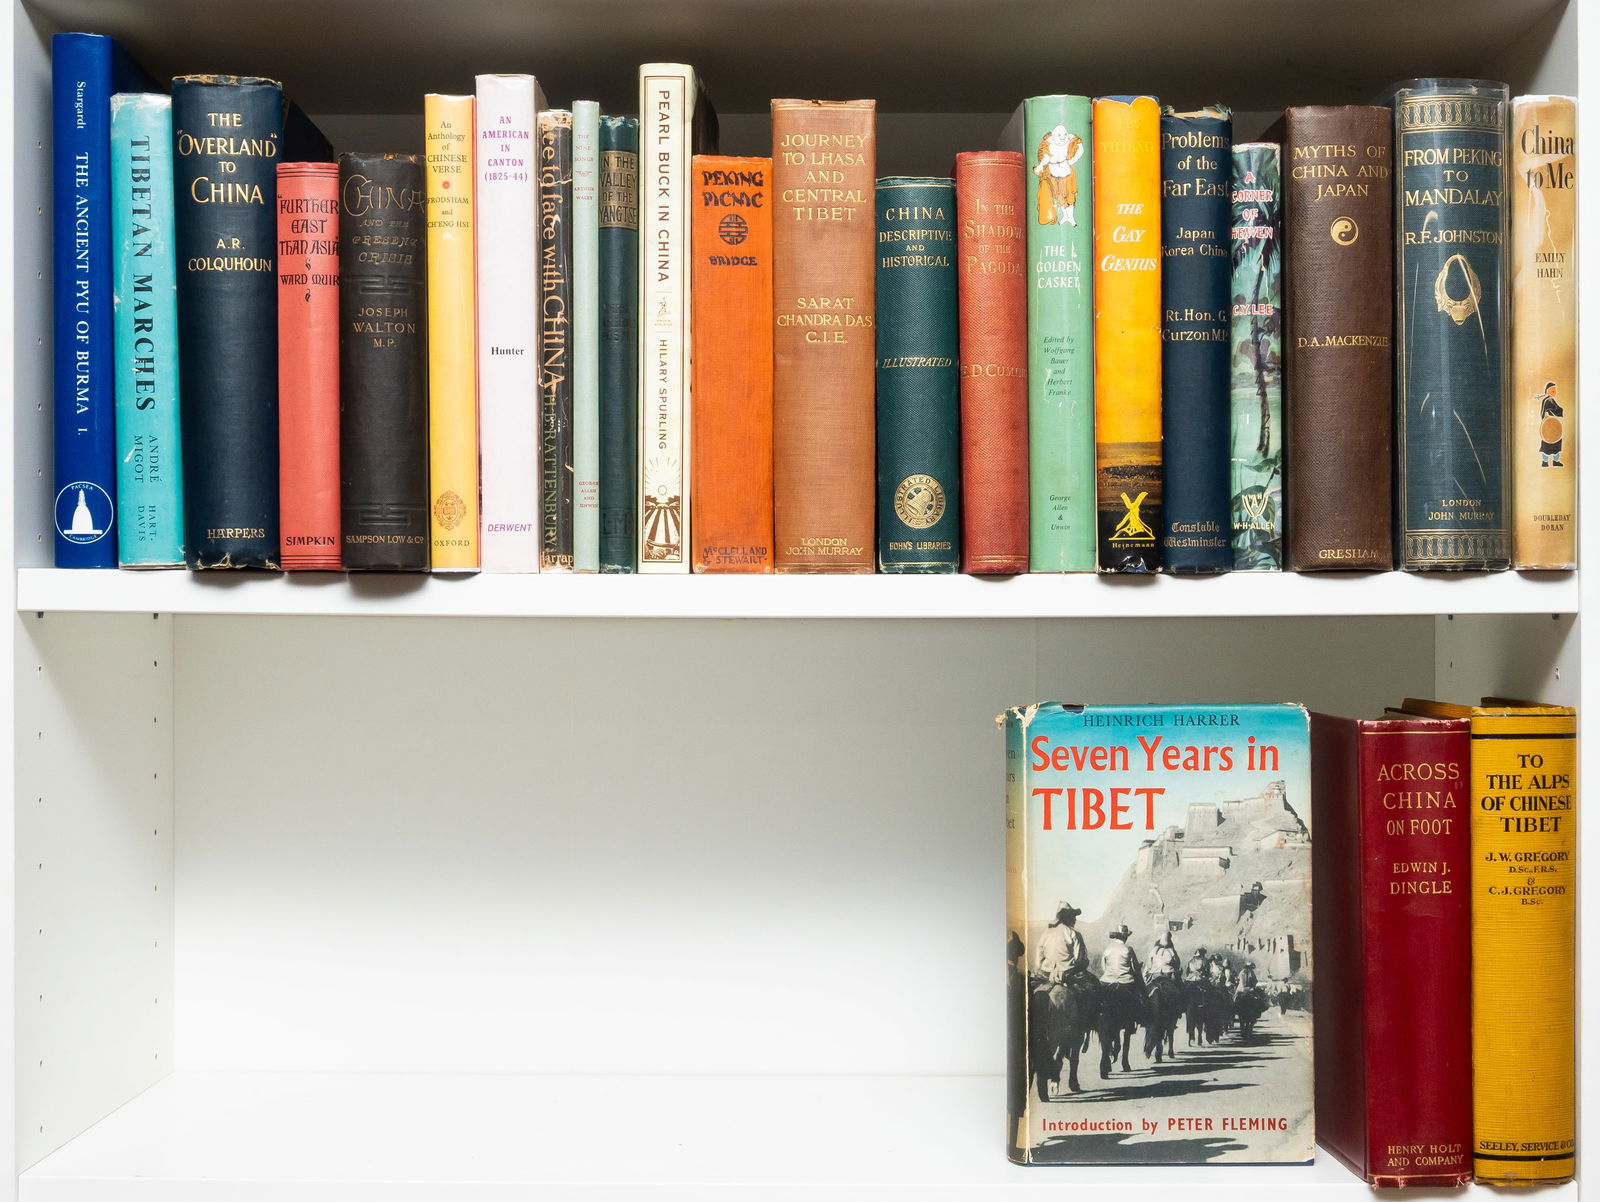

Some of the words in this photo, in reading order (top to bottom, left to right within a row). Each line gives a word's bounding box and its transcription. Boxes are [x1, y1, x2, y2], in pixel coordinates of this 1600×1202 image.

[74, 81, 87, 129] Stargardt
[208, 113, 242, 128] THE
[440, 121, 452, 129] An
[499, 116, 512, 125] AN
[658, 91, 670, 145] PEARL
[427, 132, 466, 142] Anthology
[482, 130, 530, 140] AMERICAN
[780, 134, 867, 149] JOURNEY
[1162, 130, 1229, 150] Problems
[1521, 125, 1575, 156] China
[441, 143, 450, 151] of
[500, 144, 510, 153] IN
[1293, 144, 1357, 160] MYTHS
[1367, 146, 1386, 158] OF
[427, 154, 467, 163] CHINESE
[487, 158, 524, 167] CANTON
[615, 157, 635, 170] THE
[782, 152, 805, 166] TO
[811, 152, 867, 166] LHASA
[1177, 155, 1193, 171] of
[1196, 156, 1218, 171] the
[1404, 148, 1450, 167] FROM
[1453, 148, 1503, 167] PEKING
[76, 152, 89, 187] THE
[219, 162, 237, 173] TO
[432, 165, 462, 174] VERSE
[1292, 164, 1347, 180] CHINA
[1356, 165, 1389, 179] AND
[484, 172, 528, 182] (1825-44)
[600, 173, 637, 189] VALLEY
[658, 152, 670, 198] BUCK
[702, 170, 764, 188] PEKING
[804, 170, 845, 184] AND
[1443, 170, 1469, 182] TO
[1526, 167, 1543, 190] to
[1545, 162, 1574, 190] Me
[191, 176, 265, 206] CHINA
[1163, 179, 1191, 198] Far
[1196, 178, 1229, 197] East
[1315, 183, 1369, 201] JAPAN
[131, 135, 152, 258] TIBETAN
[343, 174, 425, 217] CHINA
[426, 196, 469, 205] FRODSHAM
[602, 192, 613, 203] OF
[616, 192, 633, 204] THE
[702, 190, 764, 209] PICNIC
[782, 189, 867, 204] CENTRAL
[1231, 189, 1273, 202] CORNER
[1404, 188, 1503, 207] MANDALAY
[441, 208, 454, 216] and
[599, 206, 637, 225] YANGTSE
[658, 206, 670, 222] IN
[793, 207, 857, 222] TIBET
[886, 207, 945, 221] CHINA
[1116, 203, 1145, 216] THE
[1242, 208, 1259, 221] OF
[543, 194, 563, 241] face
[76, 195, 89, 272] ANCIENT
[291, 219, 328, 234] EAST
[1231, 226, 1273, 240] HEAVEN
[879, 229, 952, 243] DESCRIPTIVE
[1112, 225, 1147, 244] GAY
[1176, 227, 1216, 241] Japan
[216, 238, 245, 250] A.R.
[280, 240, 309, 256] THAN
[905, 244, 925, 252] AND
[1043, 244, 1065, 258] THE
[658, 229, 670, 283] CHINA
[707, 255, 758, 266] BRIDGE
[882, 255, 950, 268] HISTORICAL
[1101, 254, 1158, 272] GENIUS
[1535, 253, 1567, 264] EMILY
[188, 258, 272, 273] COLQUHOUN
[543, 245, 566, 293] with
[1036, 261, 1081, 273] GOLDEN
[280, 274, 308, 286] WARD
[312, 274, 340, 286] MUIR
[1537, 267, 1564, 279] HAHN
[1038, 276, 1080, 290] CASKET
[76, 280, 89, 314] PYU
[796, 297, 855, 310] SARAT
[358, 307, 408, 318] JOSEPH
[777, 314, 842, 327] CHANDRA
[845, 315, 873, 328] DAS
[76, 320, 89, 344] OF
[353, 322, 416, 335] WALTON
[1162, 328, 1210, 342] Curzon
[133, 275, 155, 411] MARCHES
[373, 338, 397, 348] M.P.
[806, 331, 849, 345] C.I.E.
[1043, 335, 1064, 344] Edited
[1066, 335, 1074, 345] by
[490, 346, 525, 356] Hunter
[659, 339, 668, 384] HILARY
[882, 358, 952, 369] ILLUSTRATED
[76, 351, 90, 414] BURMA
[1047, 378, 1073, 386] Herbert
[658, 388, 668, 450] SPURLING
[134, 435, 144, 483] MIGOT
[149, 434, 162, 483] ANDRÉ
[1049, 494, 1072, 503] George
[1441, 499, 1482, 508] LONDON
[137, 505, 146, 541] DAVIS
[1428, 511, 1454, 521] JOHN
[1459, 512, 1495, 521] MURRAY
[1532, 513, 1571, 522] DOUBLEDAY
[207, 528, 265, 540] HARPERS
[488, 523, 533, 533] DERWENT
[1540, 523, 1564, 532] DORAN
[286, 536, 336, 546] SIMPKIN
[345, 535, 385, 544] SAMPSON
[387, 535, 407, 544] LOW
[801, 538, 847, 546] LONDON
[916, 541, 952, 550] LIBRARIES
[1112, 541, 1155, 549] Heinemann
[785, 547, 816, 555] JOHN
[819, 547, 864, 555] MURRAY
[1318, 549, 1379, 560] GRESHAM
[1082, 714, 1164, 728] HEINRICH
[1172, 714, 1240, 727] HARRER
[1030, 735, 1129, 772] Seven
[1136, 735, 1234, 772] Years
[1246, 735, 1279, 771] in
[1516, 754, 1544, 769] TO
[1377, 762, 1460, 782] ACROSS
[1486, 773, 1523, 791] THE
[1527, 773, 1570, 790] ALPS
[1383, 791, 1457, 810] CHINA
[1480, 795, 1506, 812] OF
[1509, 795, 1571, 811] CHINESE
[1031, 787, 1166, 831] TIBET
[1386, 820, 1404, 836] ON
[1410, 818, 1453, 835] FOOT
[1499, 816, 1562, 833] TIBET
[1514, 851, 1570, 862] GREGORY
[1392, 861, 1438, 874] EDWIN
[1441, 861, 1451, 876] J.
[1389, 880, 1452, 895] DINGLE
[1041, 1118, 1132, 1131] Introduction
[1141, 1118, 1158, 1135] by
[1166, 1118, 1214, 1131] PETER
[1222, 1118, 1288, 1131] FLEMING
[1387, 1144, 1424, 1155] HENRY
[1430, 1143, 1462, 1154] HOLT
[1479, 1140, 1519, 1153] SEELEY,
[1520, 1141, 1560, 1152] SERVICE
[1387, 1156, 1410, 1167] AND
[1414, 1155, 1464, 1167] COMPANY
